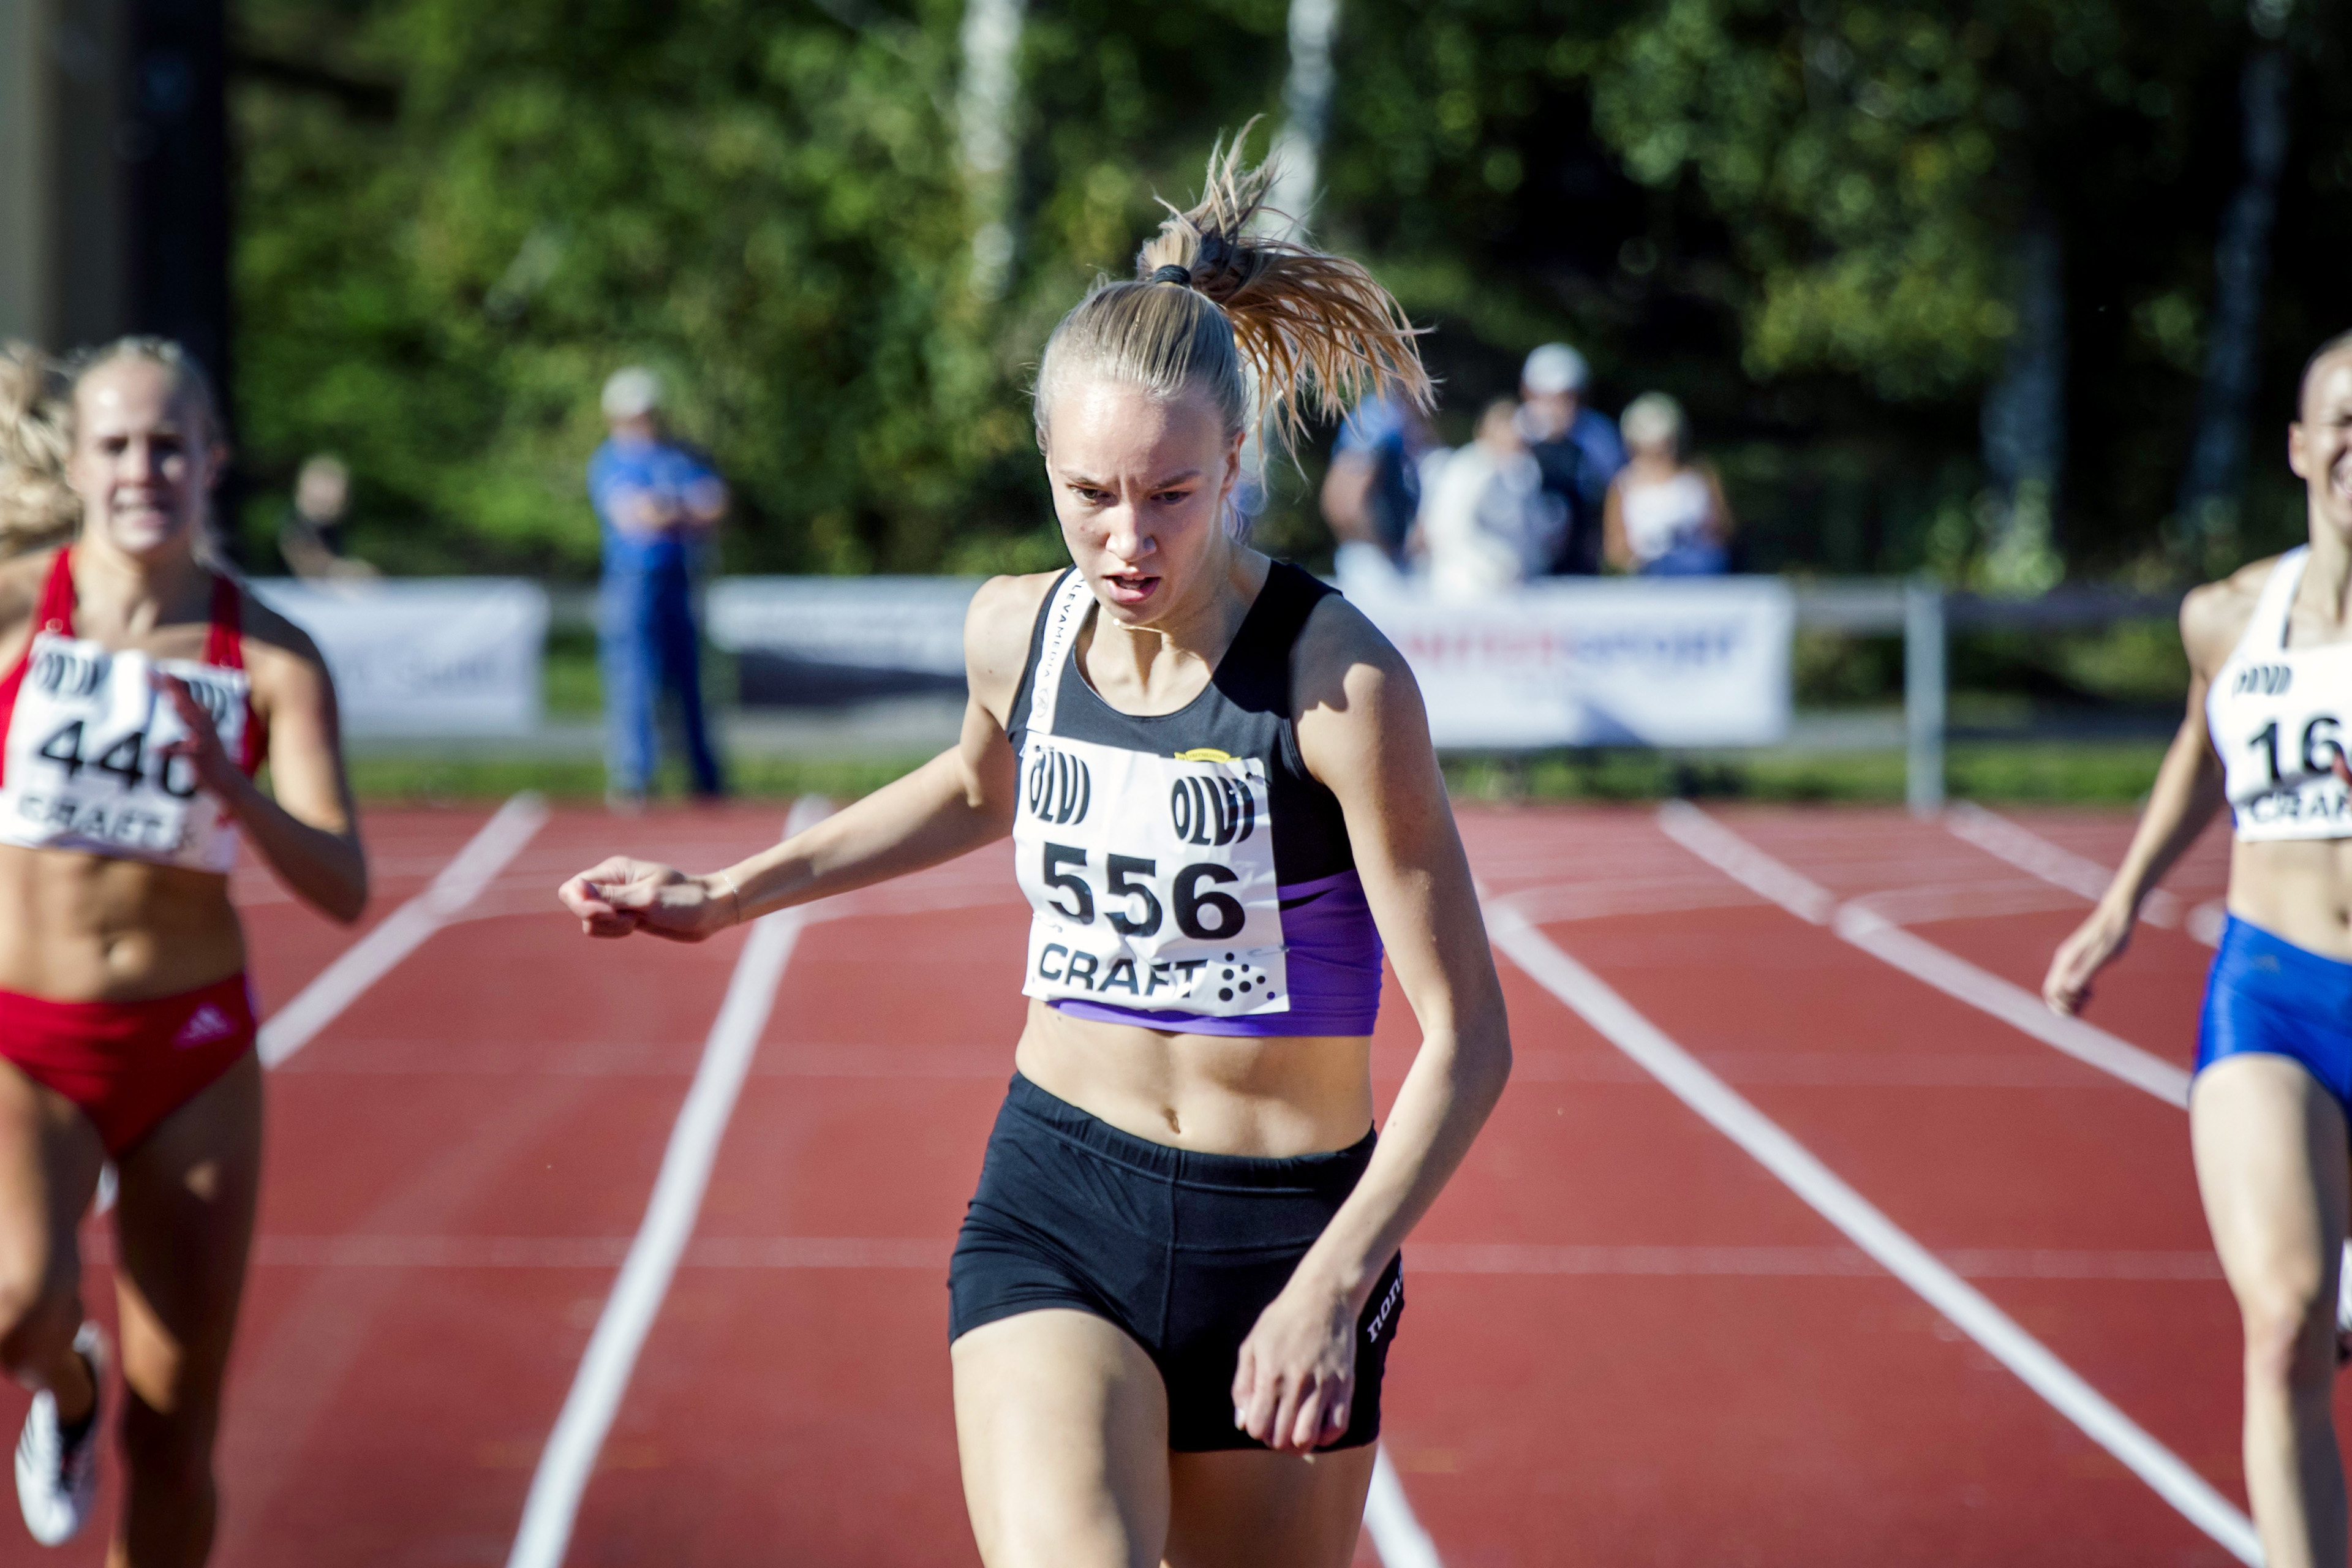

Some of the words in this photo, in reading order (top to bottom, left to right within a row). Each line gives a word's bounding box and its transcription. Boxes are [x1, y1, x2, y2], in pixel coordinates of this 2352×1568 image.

[1171, 776, 1255, 846] OLVI
[1042, 841, 1245, 941] 556
[1039, 943, 1210, 999] CRAFT
